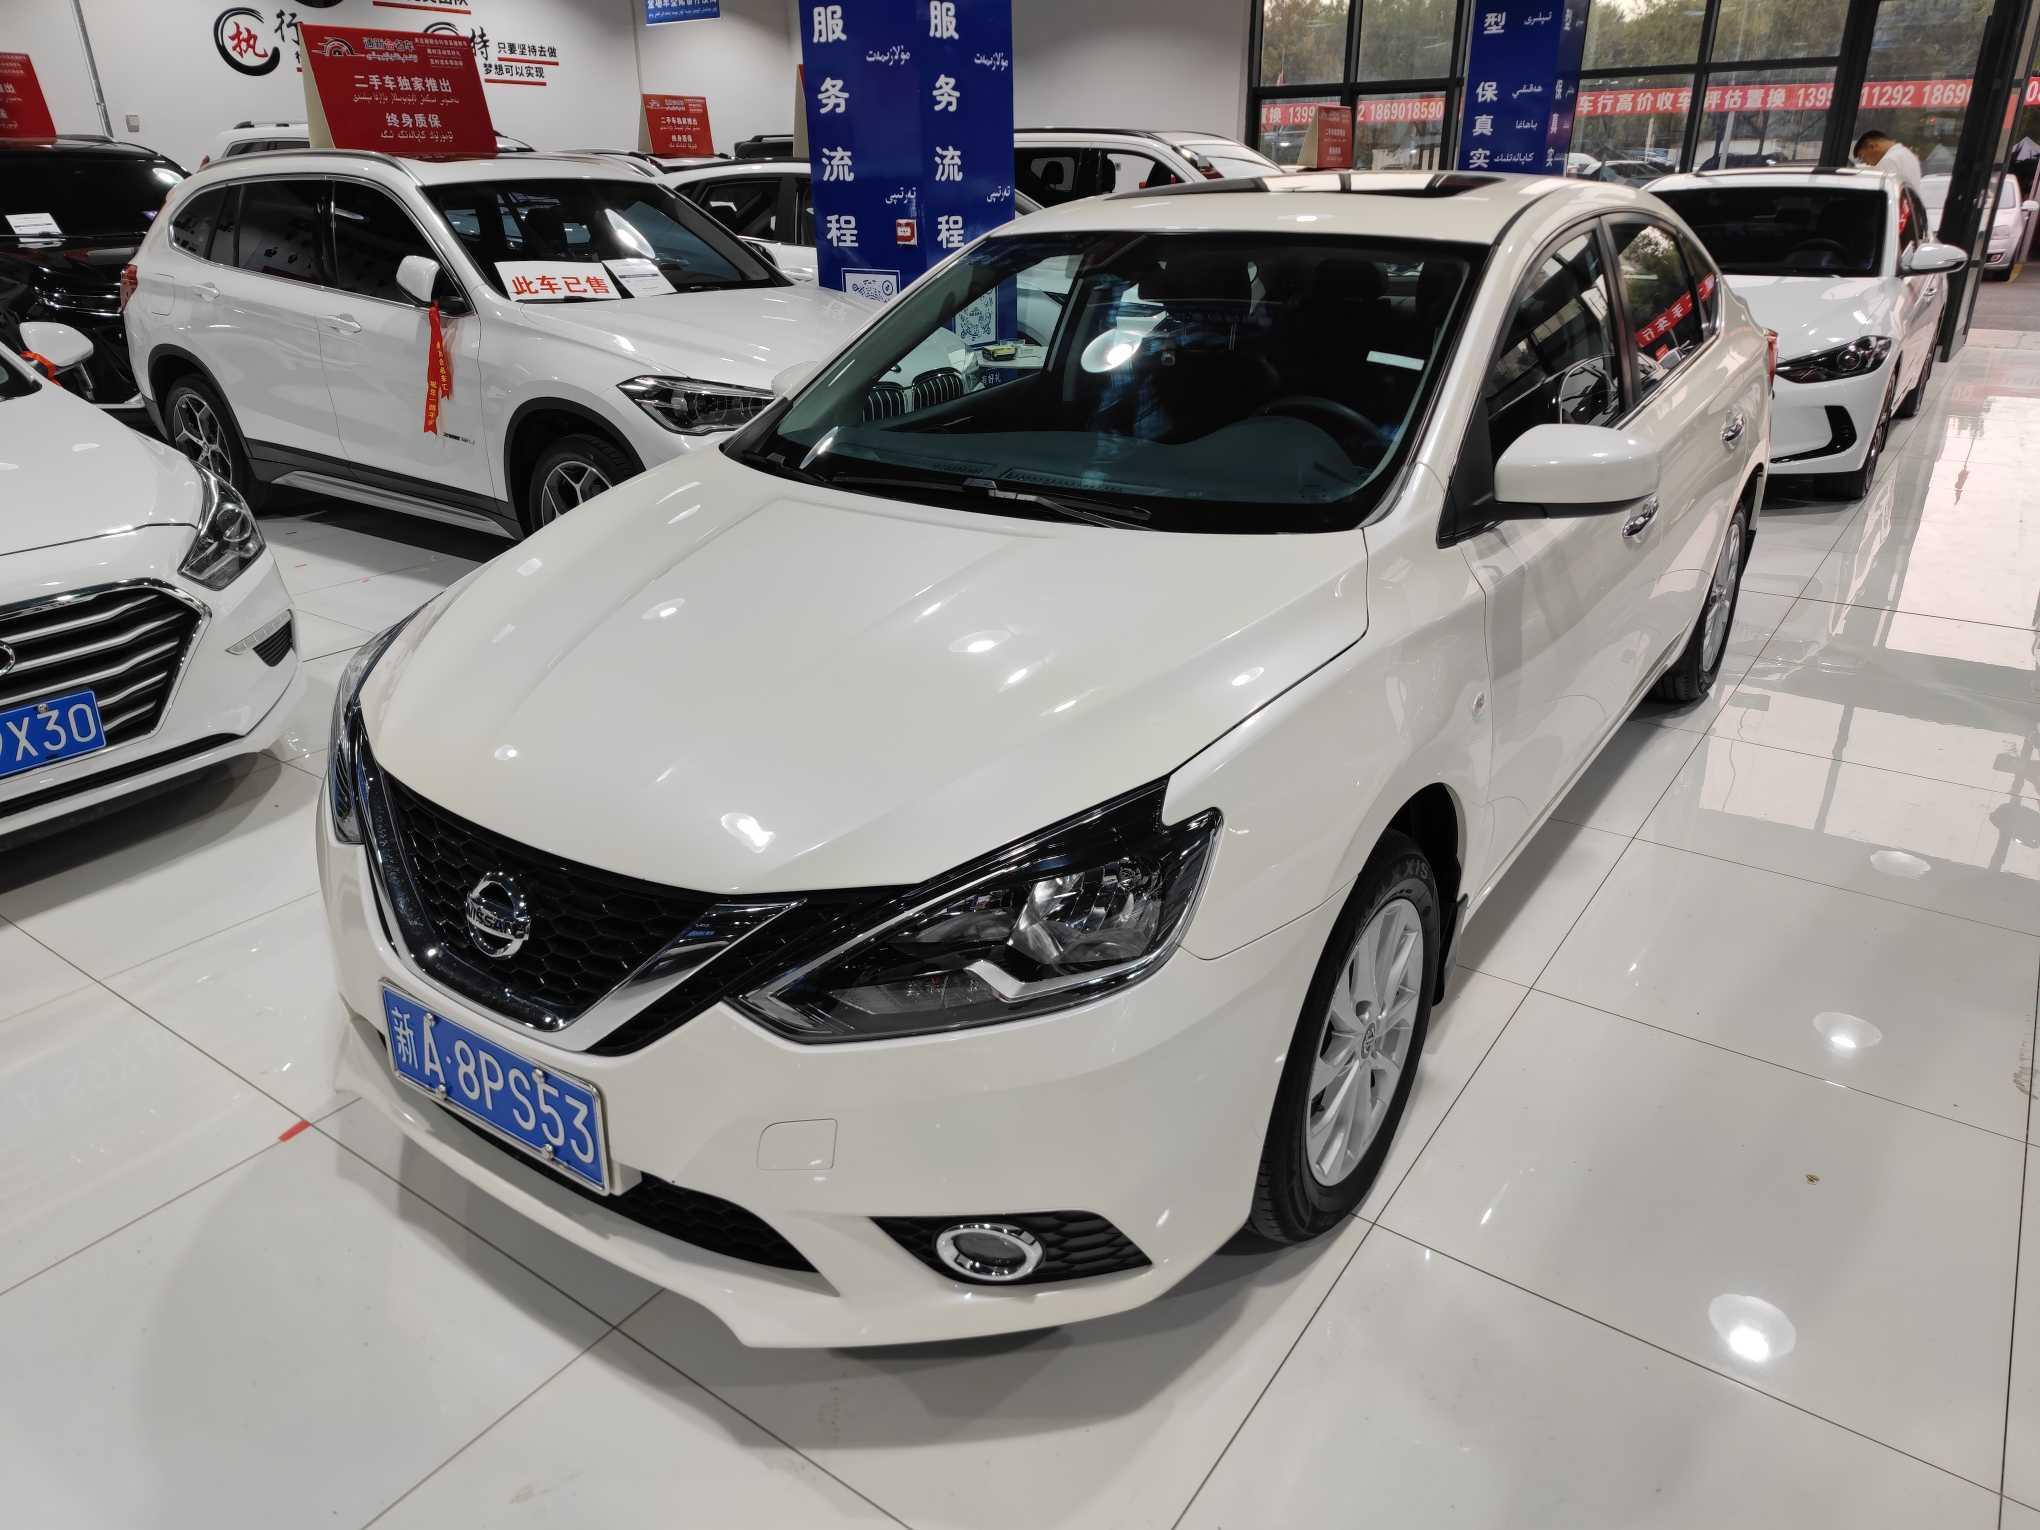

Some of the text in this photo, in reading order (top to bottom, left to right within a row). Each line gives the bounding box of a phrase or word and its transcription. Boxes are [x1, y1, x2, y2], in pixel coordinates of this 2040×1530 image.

[1483, 11, 1507, 35] 型
[497, 42, 558, 58] 只要坚持去做
[482, 63, 546, 79] 梦想可以实现
[353, 74, 453, 93] 二手车独家推出
[1921, 82, 1973, 105] 1869
[1703, 88, 1787, 110] 评估置换
[385, 112, 442, 128] 终身质保
[812, 4, 859, 248] 服务流程
[929, 0, 966, 249] 服务流程
[1468, 81, 1499, 169] 保真实
[511, 275, 610, 296] 此车已售
[0, 703, 97, 762] X30
[391, 1006, 595, 1164] 新A·8PS53
